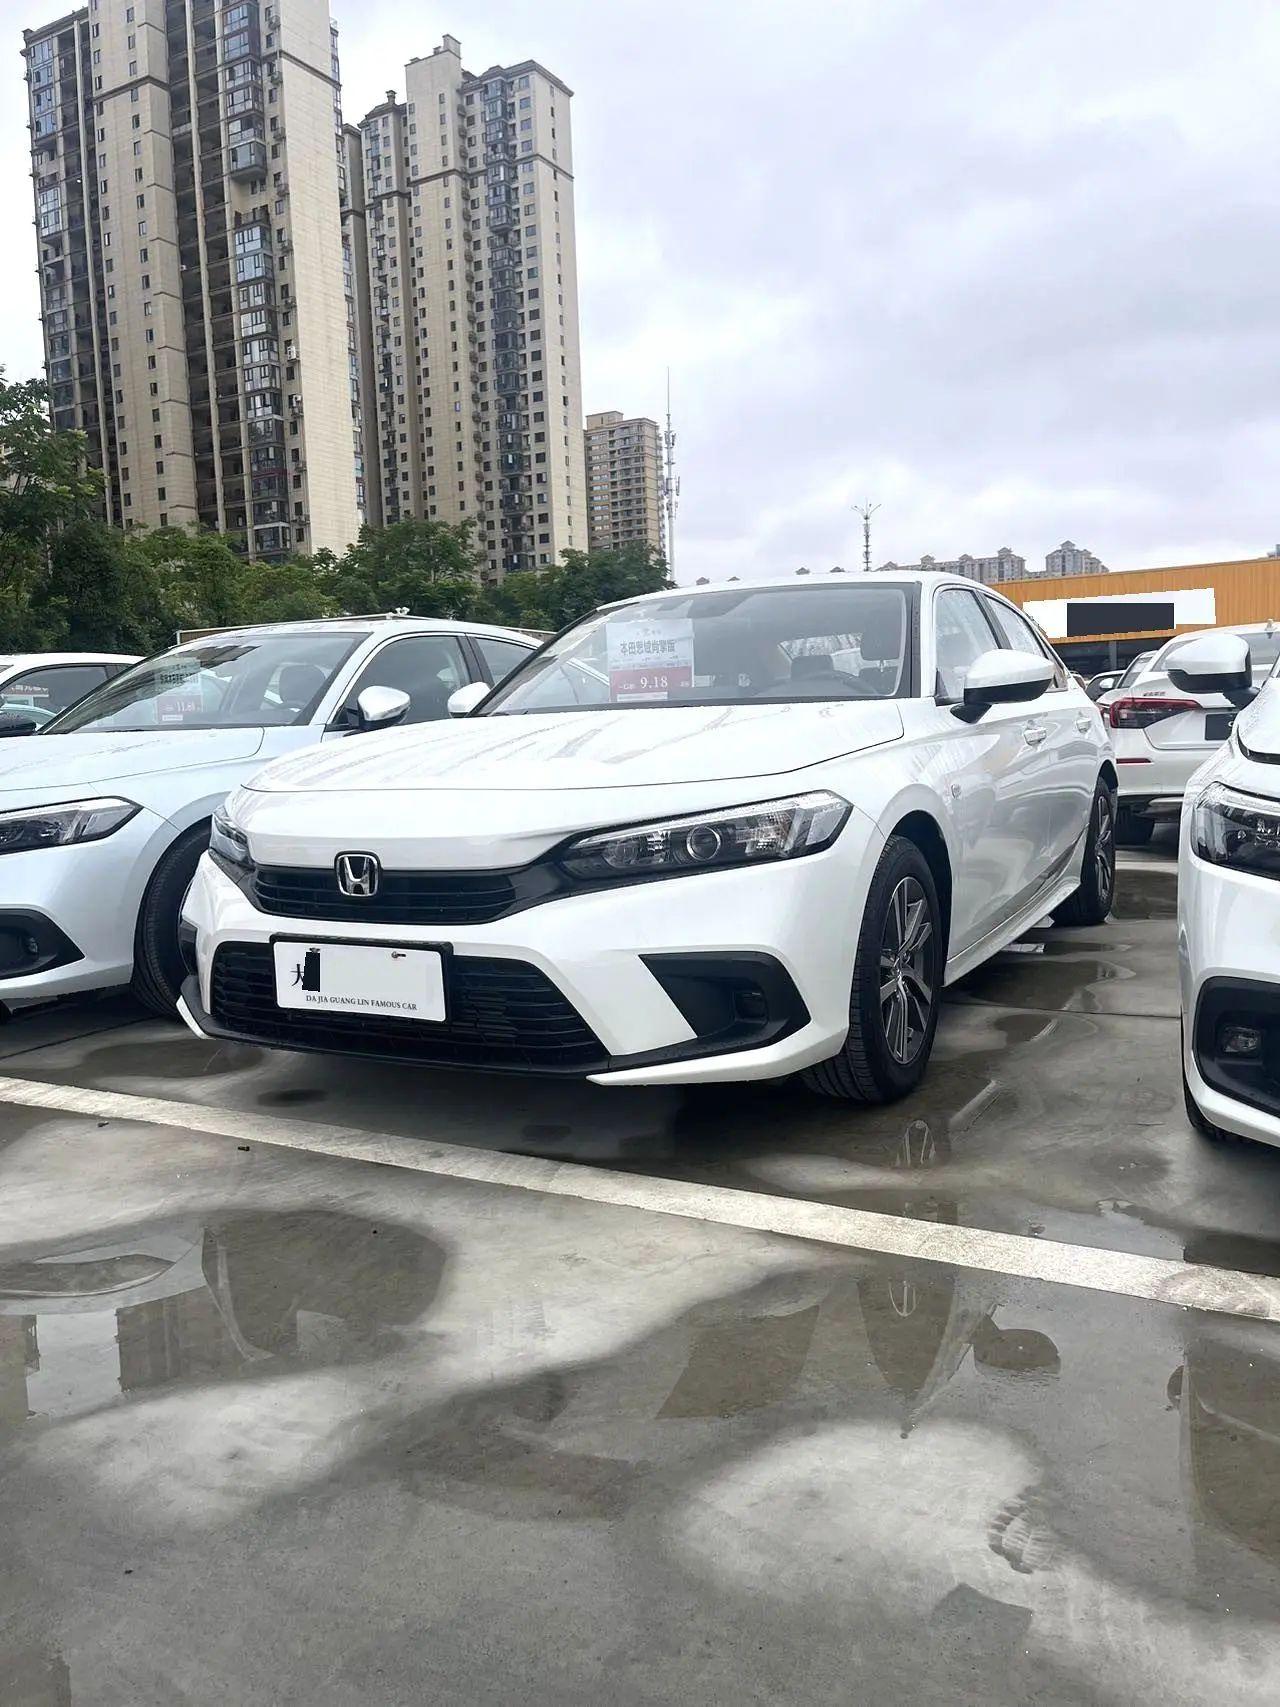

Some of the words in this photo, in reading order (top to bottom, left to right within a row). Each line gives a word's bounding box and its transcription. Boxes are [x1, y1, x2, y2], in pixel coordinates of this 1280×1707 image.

[640, 676, 668, 689] 9.18
[317, 996, 329, 1004] JIA
[330, 997, 356, 1005] GUANG
[371, 1000, 401, 1009] FAMOUS
